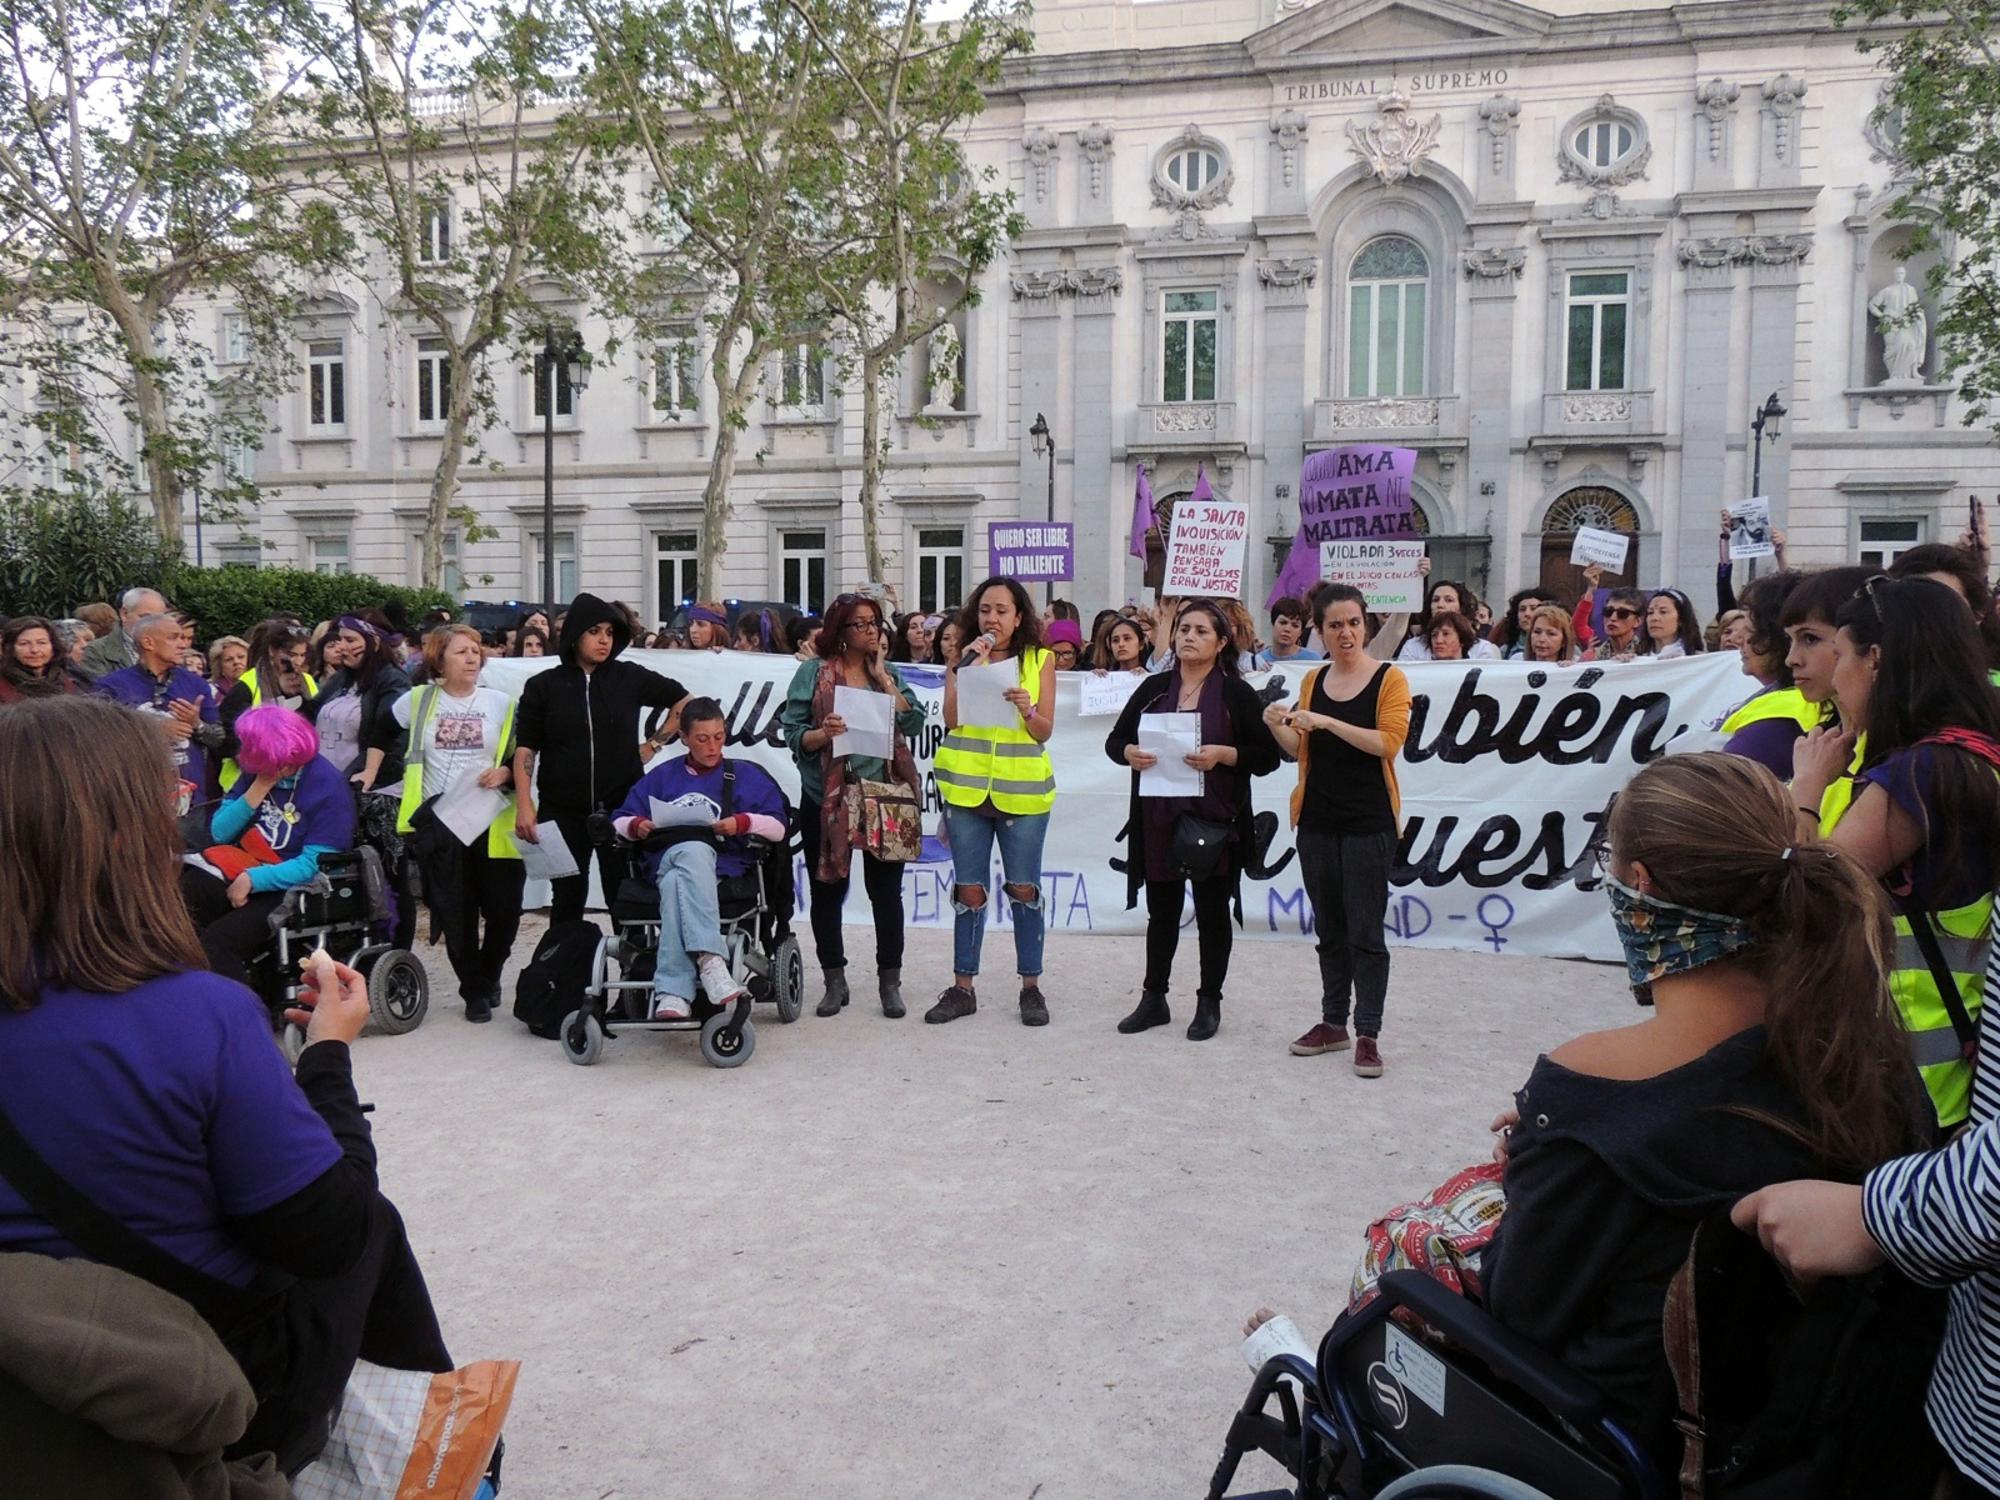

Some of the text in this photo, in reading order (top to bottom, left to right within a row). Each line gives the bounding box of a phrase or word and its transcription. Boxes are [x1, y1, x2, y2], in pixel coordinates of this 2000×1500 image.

[1285, 69, 1508, 100] TRIBUNAL SUPREMO
[1337, 451, 1394, 477] AMA
[1316, 484, 1381, 513] MATA
[1178, 508, 1246, 527] LA SANTA
[1303, 512, 1414, 542] MALTRATA
[994, 527, 1070, 551] QUIERO SER LIBRE,
[1174, 555, 1220, 568] PENSABA
[1327, 545, 1384, 560] VIOLADA
[1387, 546, 1395, 558] 3
[1000, 555, 1065, 576] NO VALIENTE
[1172, 566, 1189, 575] QUE
[1190, 566, 1211, 577] SUS
[1170, 576, 1238, 593] ERAN JUSTAS
